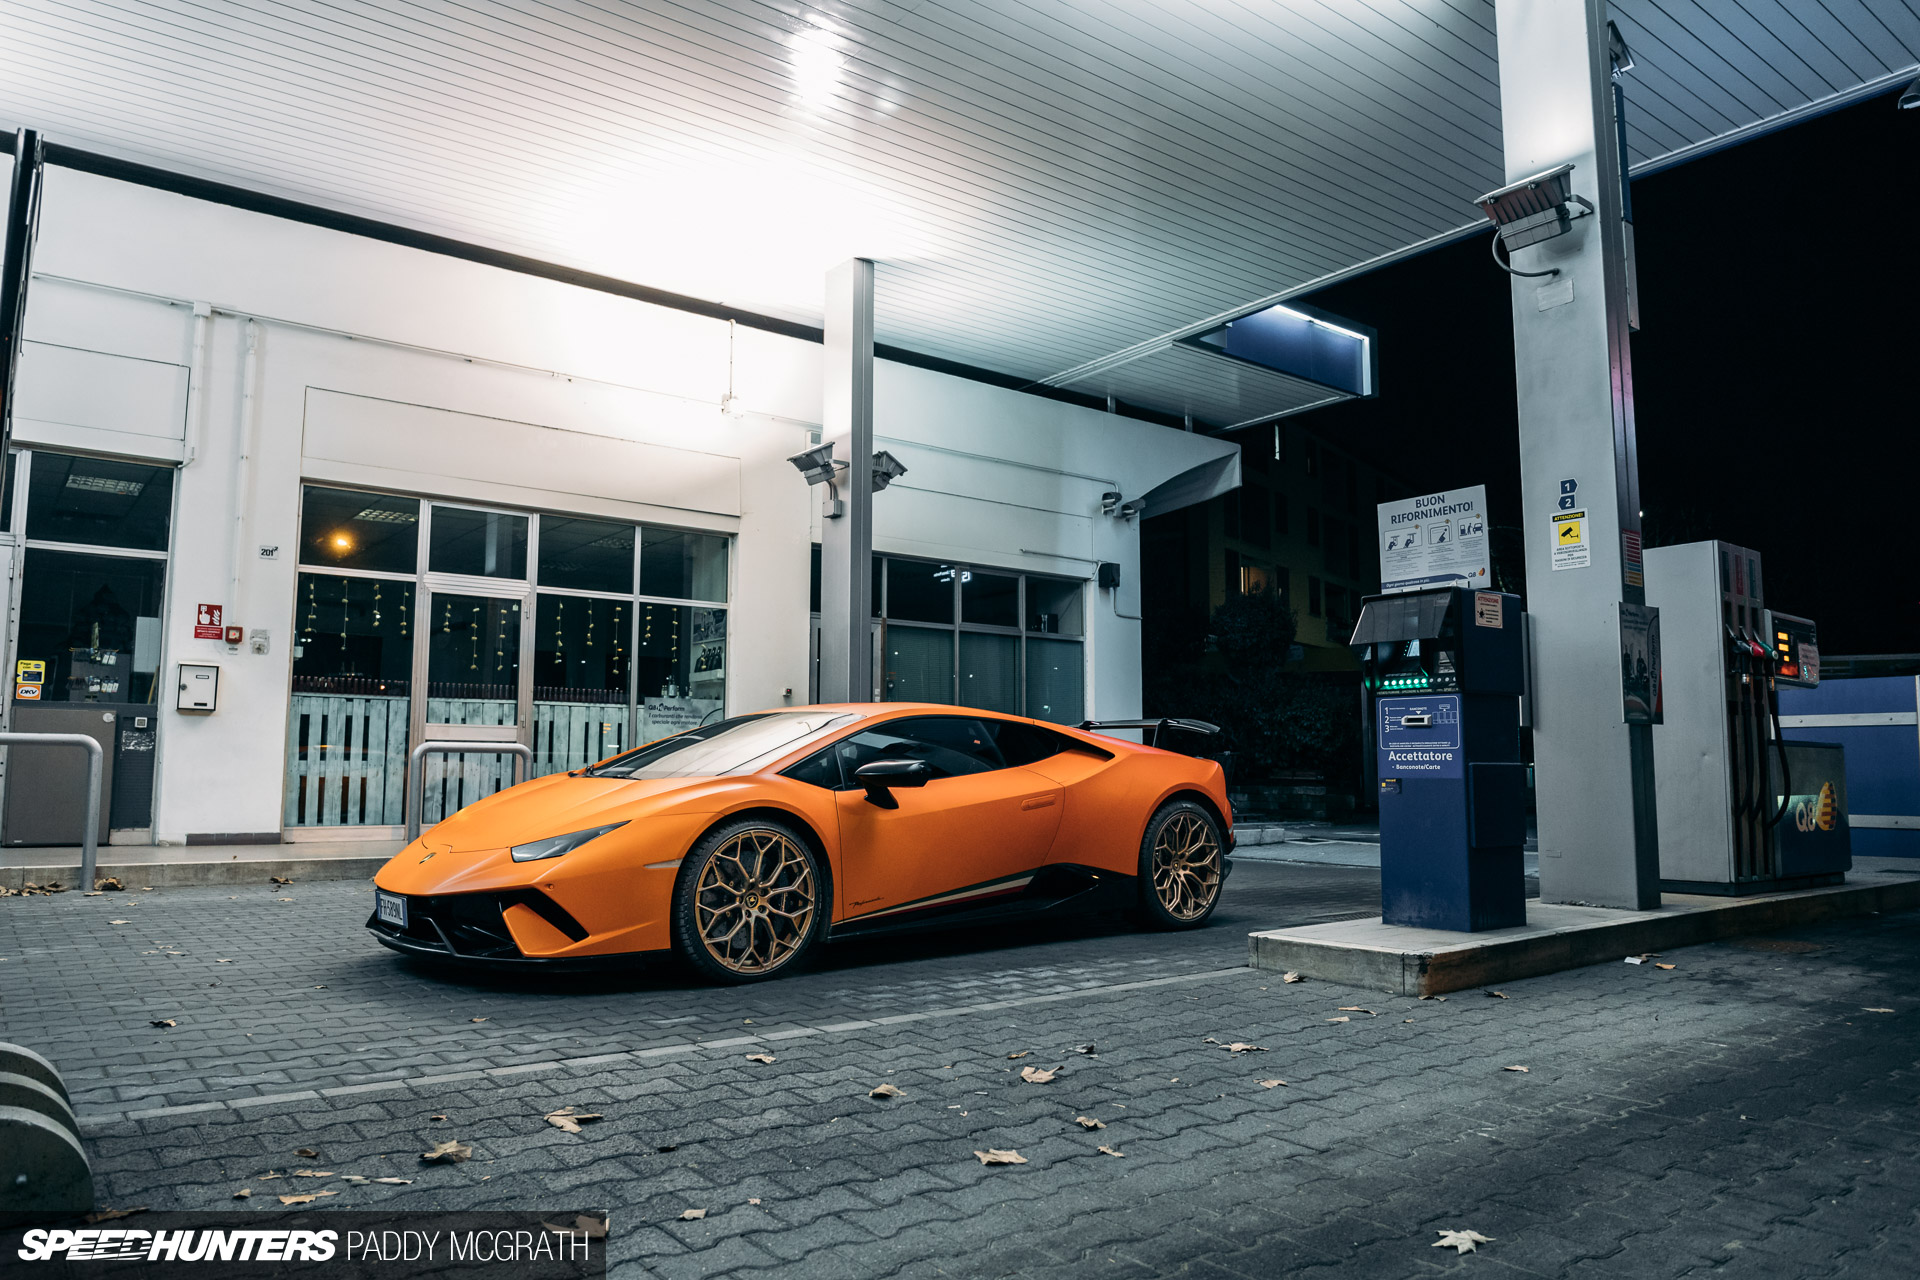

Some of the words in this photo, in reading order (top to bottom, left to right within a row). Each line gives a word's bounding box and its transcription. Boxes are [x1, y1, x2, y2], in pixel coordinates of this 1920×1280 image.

[1565, 482, 1570, 491] 1
[1415, 494, 1445, 509] BUON
[1565, 498, 1571, 507] 2
[1391, 501, 1474, 525] RIFORNIMENTO!
[1384, 707, 1389, 715] 1
[1384, 715, 1390, 724] 2
[1384, 725, 1390, 733] 3
[1388, 751, 1453, 761] Accettatore
[1795, 801, 1816, 833] Q8
